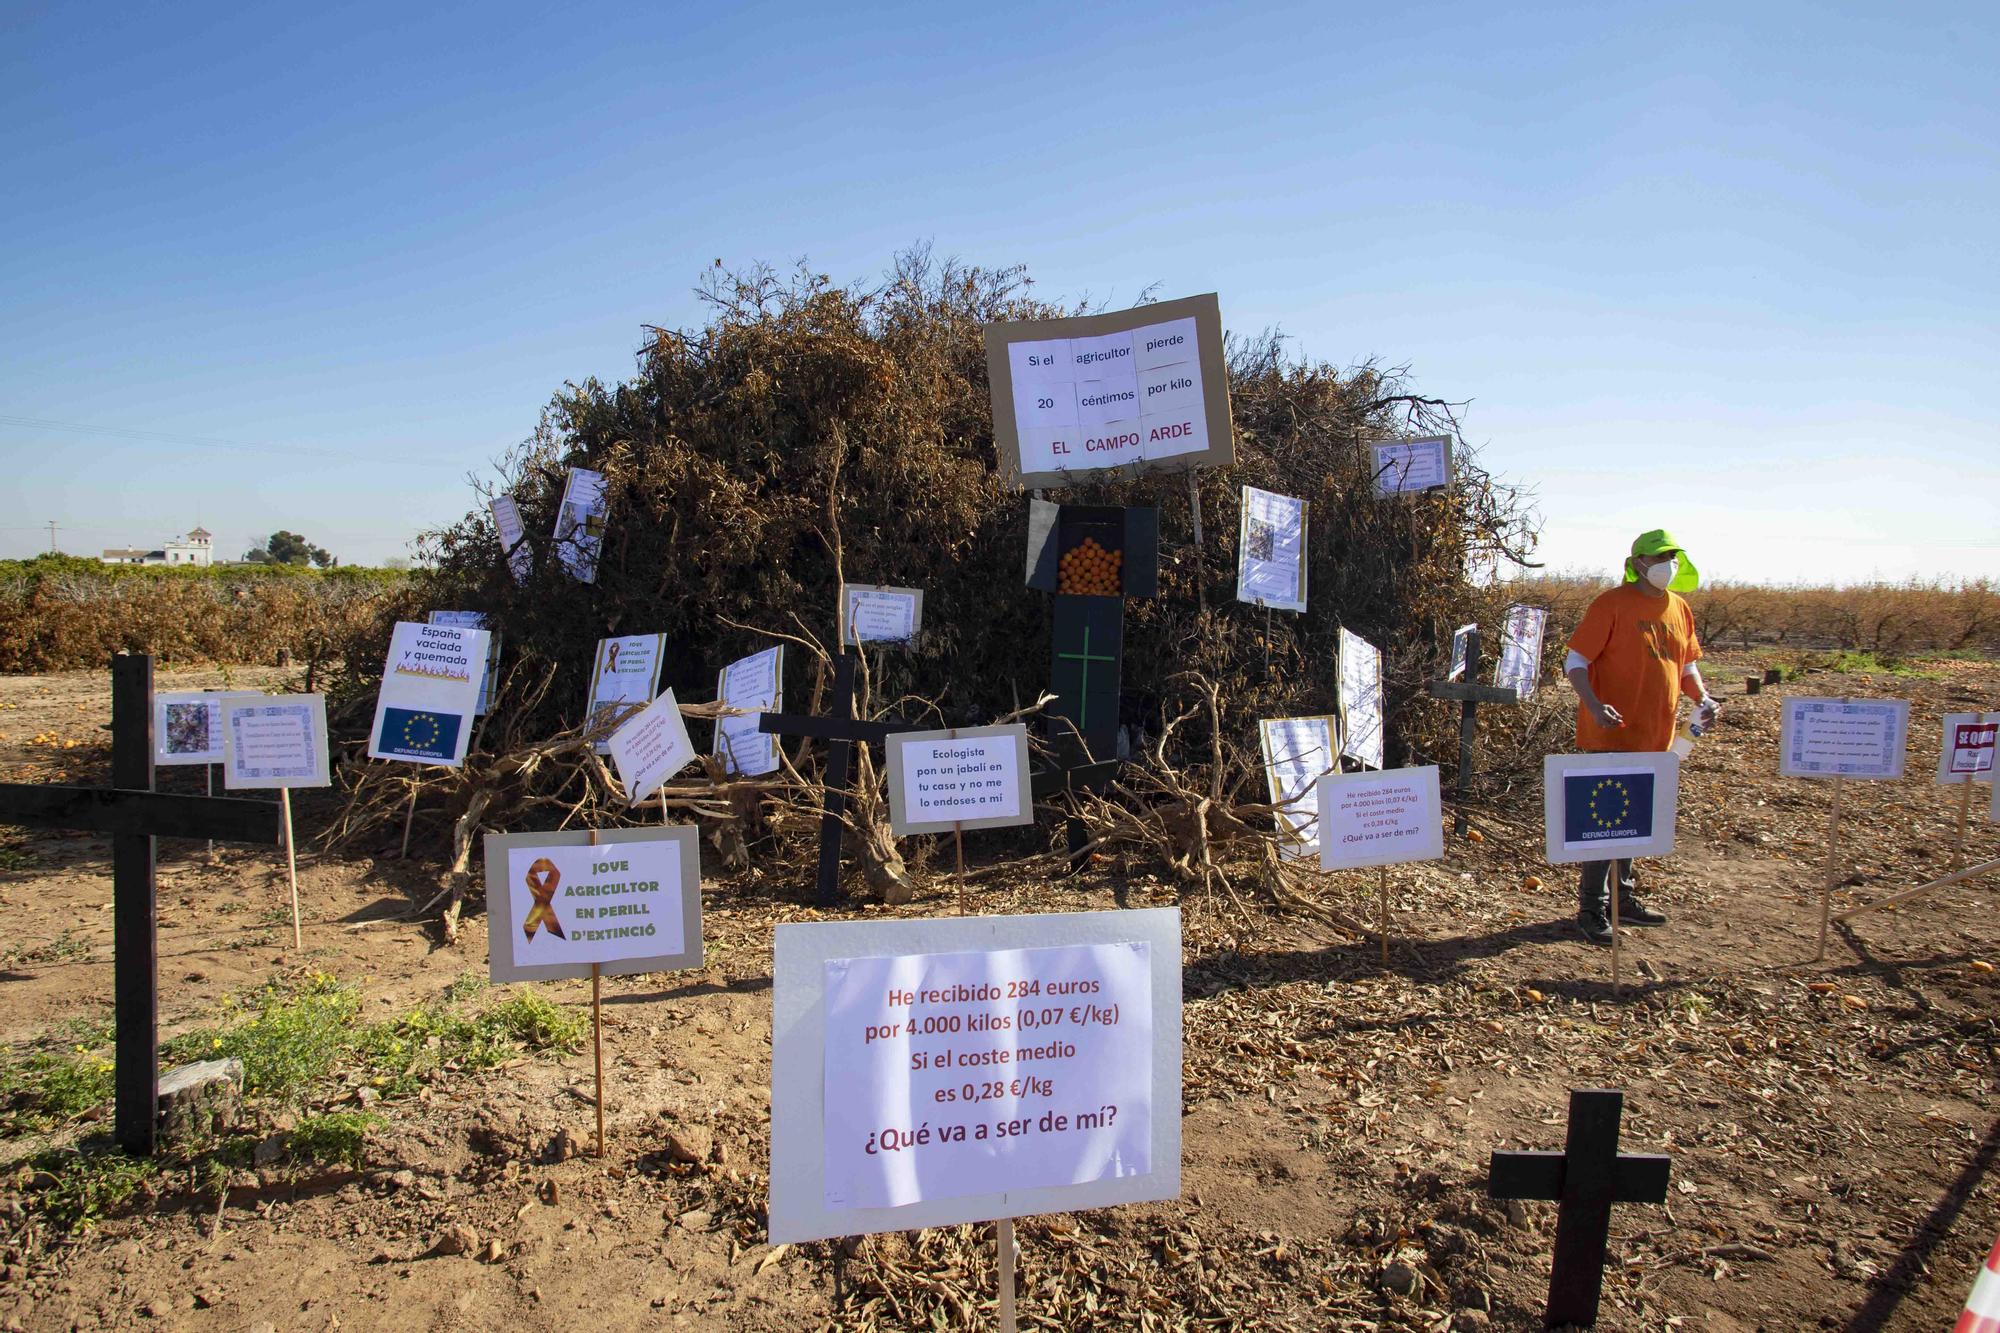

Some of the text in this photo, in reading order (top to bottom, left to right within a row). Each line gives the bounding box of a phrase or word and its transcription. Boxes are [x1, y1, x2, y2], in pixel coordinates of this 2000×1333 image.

[1028, 335, 1184, 367] Si el agricultor pierde
[1038, 378, 1192, 409] 20 céntimos por kilo
[1052, 422, 1193, 455] EL CAMPO ARDE
[421, 626, 462, 640] España
[416, 639, 462, 653] vaciada
[404, 651, 467, 665] y quemada
[932, 748, 985, 760] Ecologista
[917, 767, 937, 778] pon
[940, 766, 954, 775] un
[989, 763, 1002, 771] en
[919, 779, 1002, 791] tu casa y no me
[920, 798, 930, 807] lo
[933, 796, 976, 807] endoses
[979, 796, 986, 804] a
[1582, 829, 1638, 839] DEFUNCIÓ EUROPEA
[592, 860, 629, 876] JOVE
[564, 880, 660, 897] AGRICULTOR
[575, 903, 650, 919] EN PERILL
[571, 923, 656, 941] D'EXTINCIÓ
[888, 980, 1100, 1007] He recibido 284 euros
[865, 1003, 1120, 1045] por 4.000 kilos (0,07 €/kg)
[911, 1040, 1076, 1071] Si el coste medio
[934, 1075, 1054, 1104] es 0,28 €/kg
[864, 1104, 1118, 1155] ¿Qué va a ser de mí?
